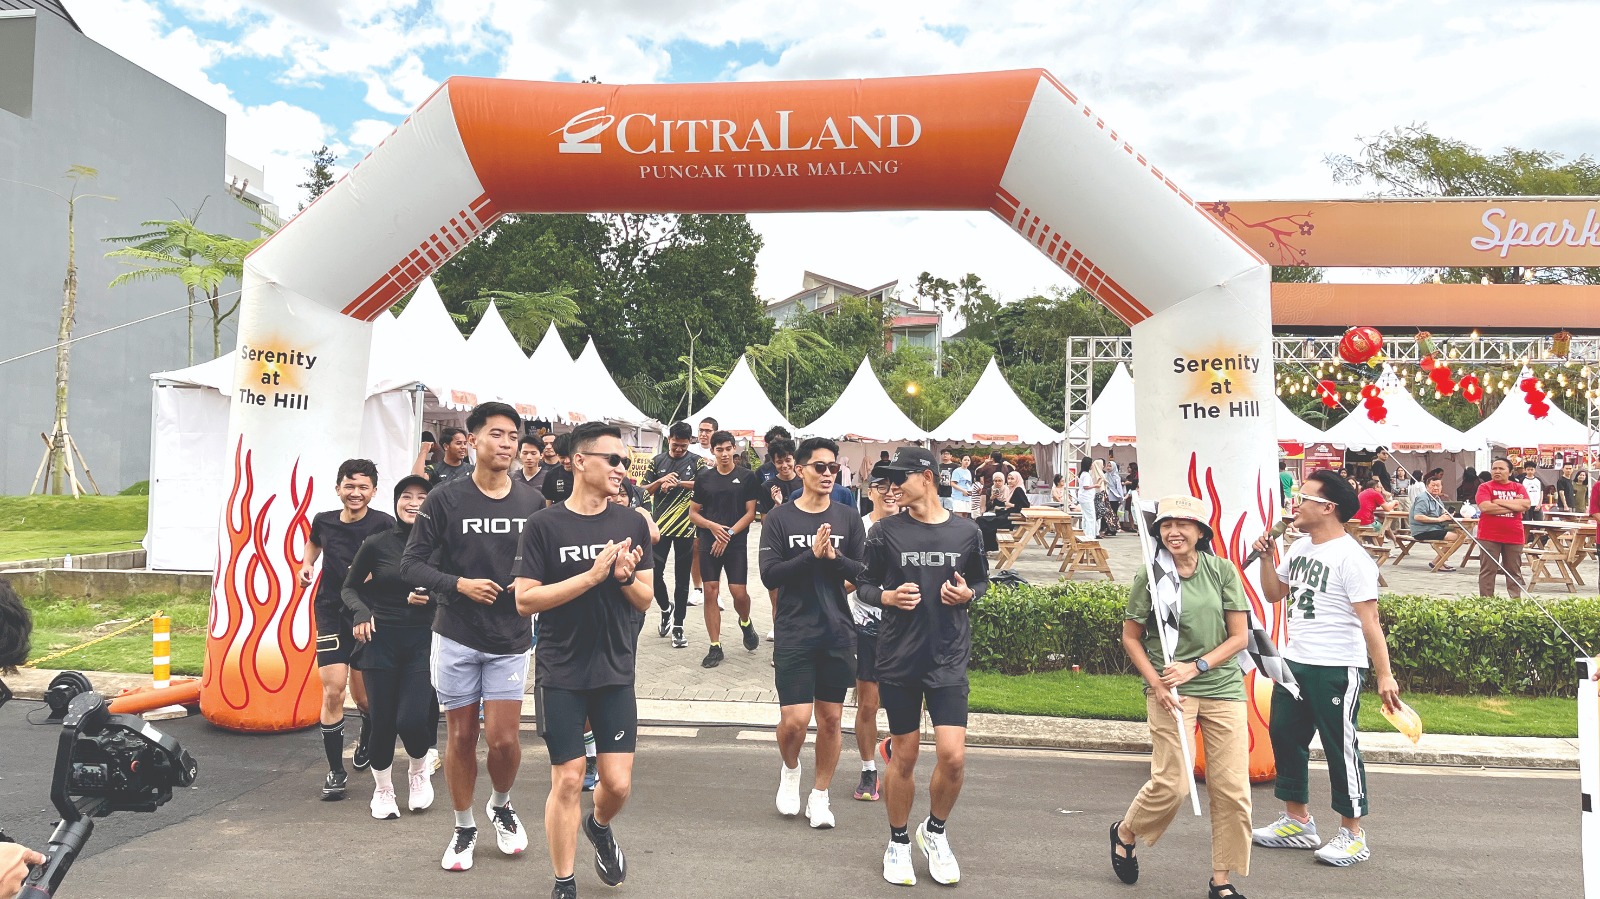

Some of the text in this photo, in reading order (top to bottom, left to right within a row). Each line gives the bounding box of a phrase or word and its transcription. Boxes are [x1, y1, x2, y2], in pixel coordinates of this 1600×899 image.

[639, 159, 899, 179] PUNCAK TIDAR MALANG
[241, 345, 317, 370] Serenity
[1173, 354, 1259, 373] Serenity
[261, 371, 280, 385] at
[1210, 379, 1232, 394] at
[239, 389, 308, 410] The Hill
[1178, 401, 1260, 419] The Hill
[631, 470, 645, 478] COFF
[462, 518, 528, 535] RIOT
[559, 544, 607, 563] RIO
[900, 551, 962, 567] RIOT
